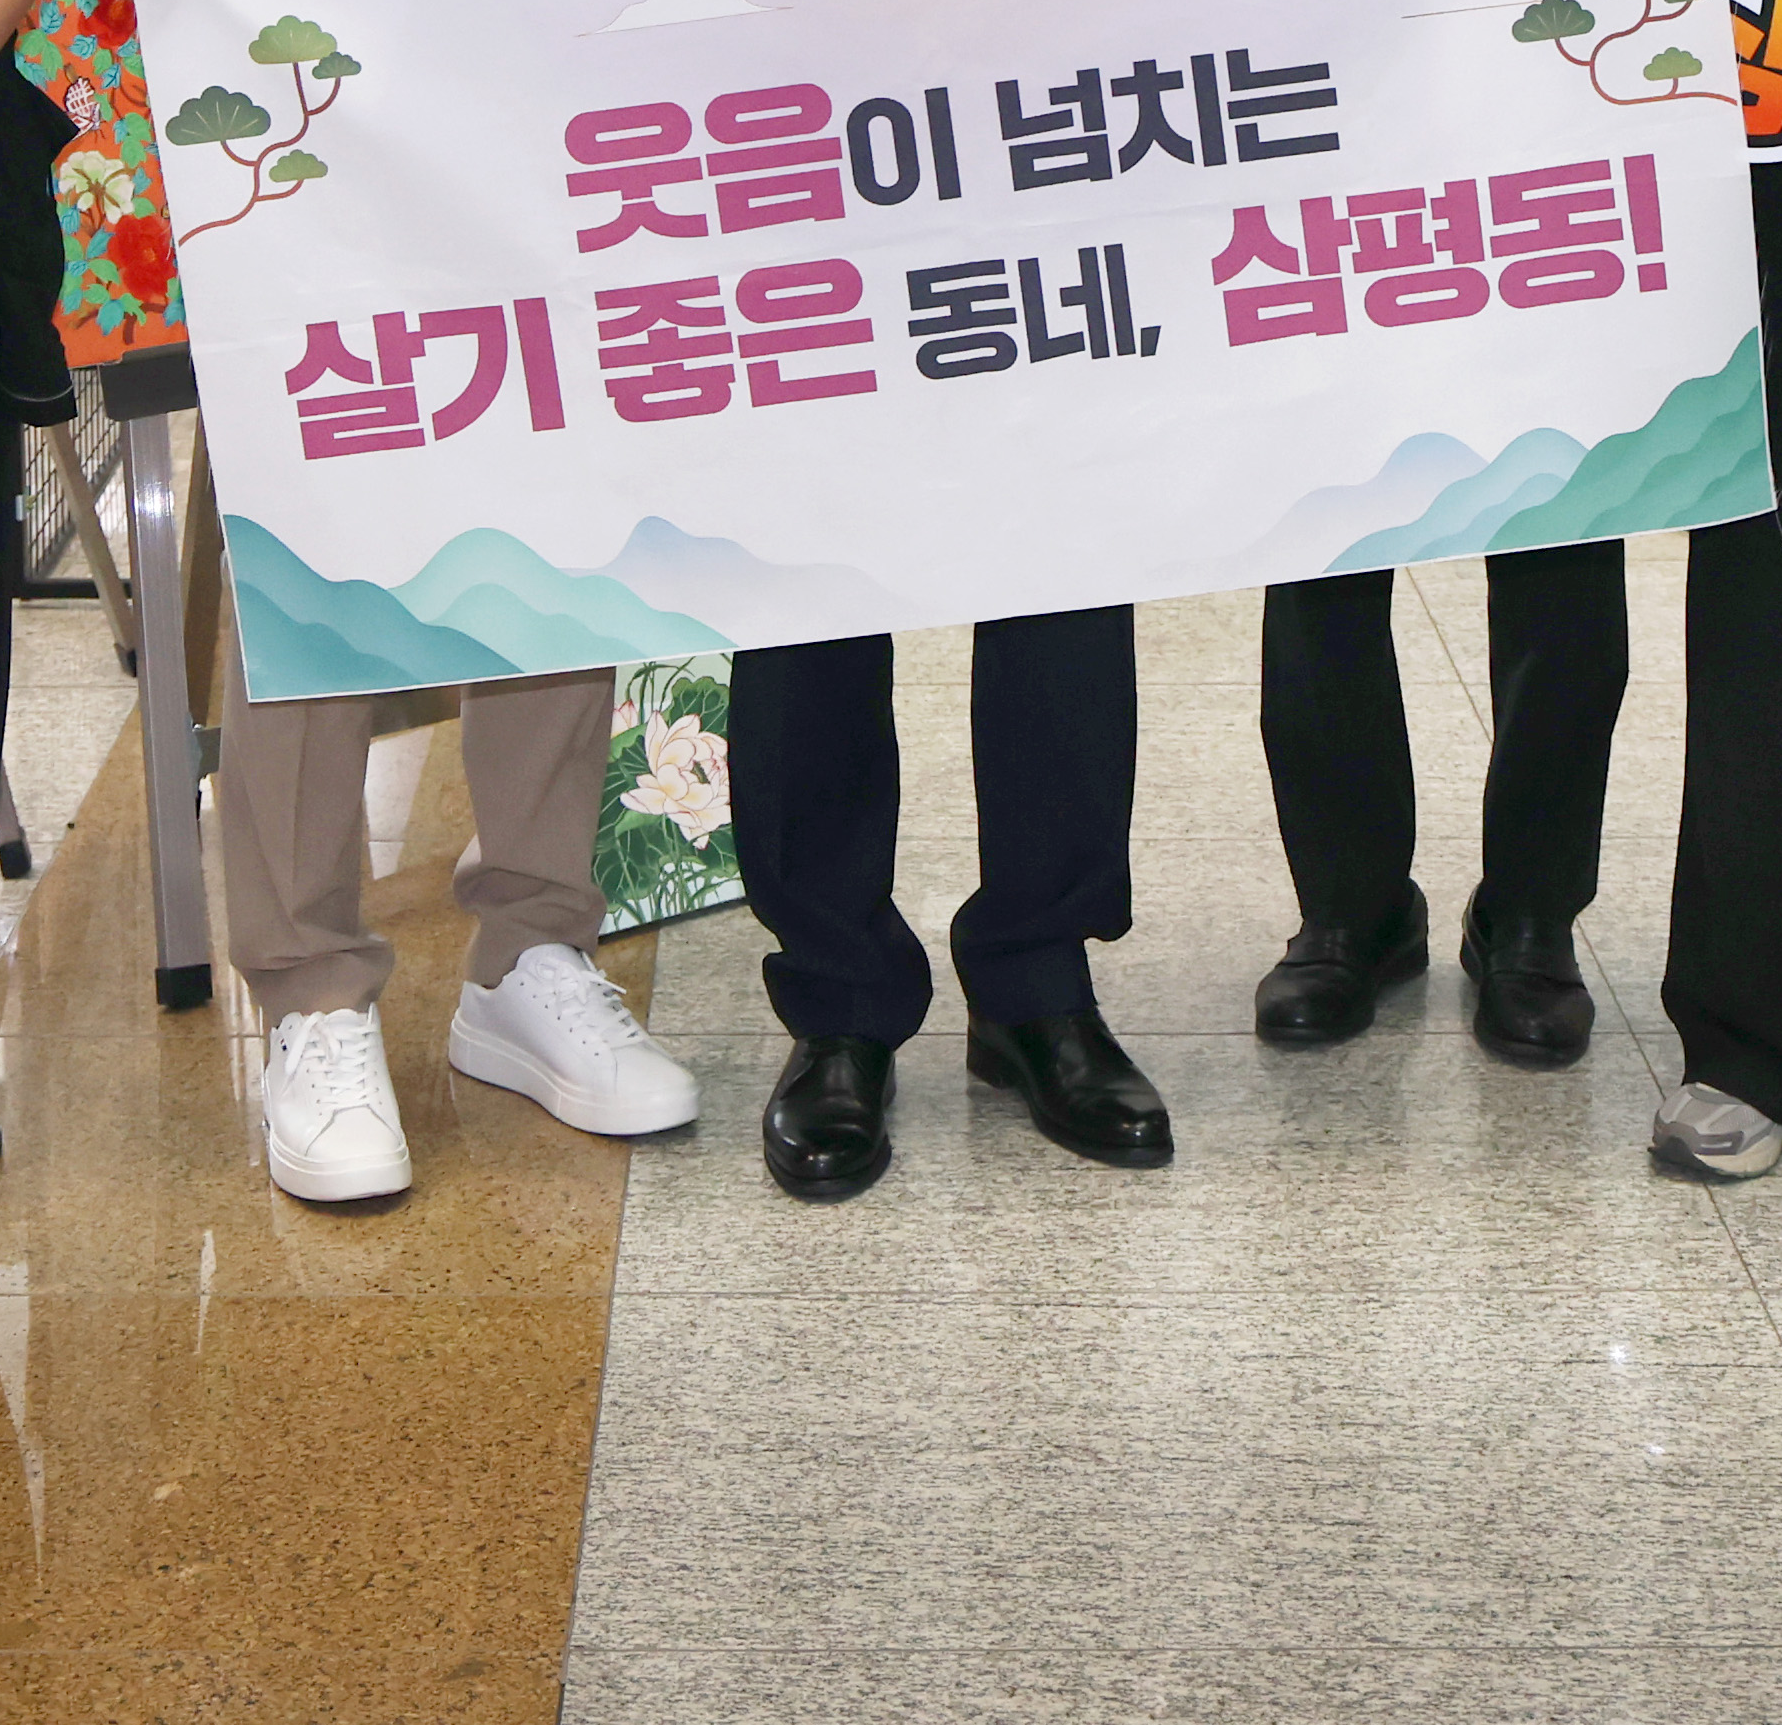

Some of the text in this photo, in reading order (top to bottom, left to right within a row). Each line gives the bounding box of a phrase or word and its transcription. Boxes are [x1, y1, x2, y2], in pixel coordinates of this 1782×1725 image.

[564, 46, 1341, 254] 웃음이 넘치는
[283, 153, 1669, 461] 살기 좋은 동네, 삼평동!
